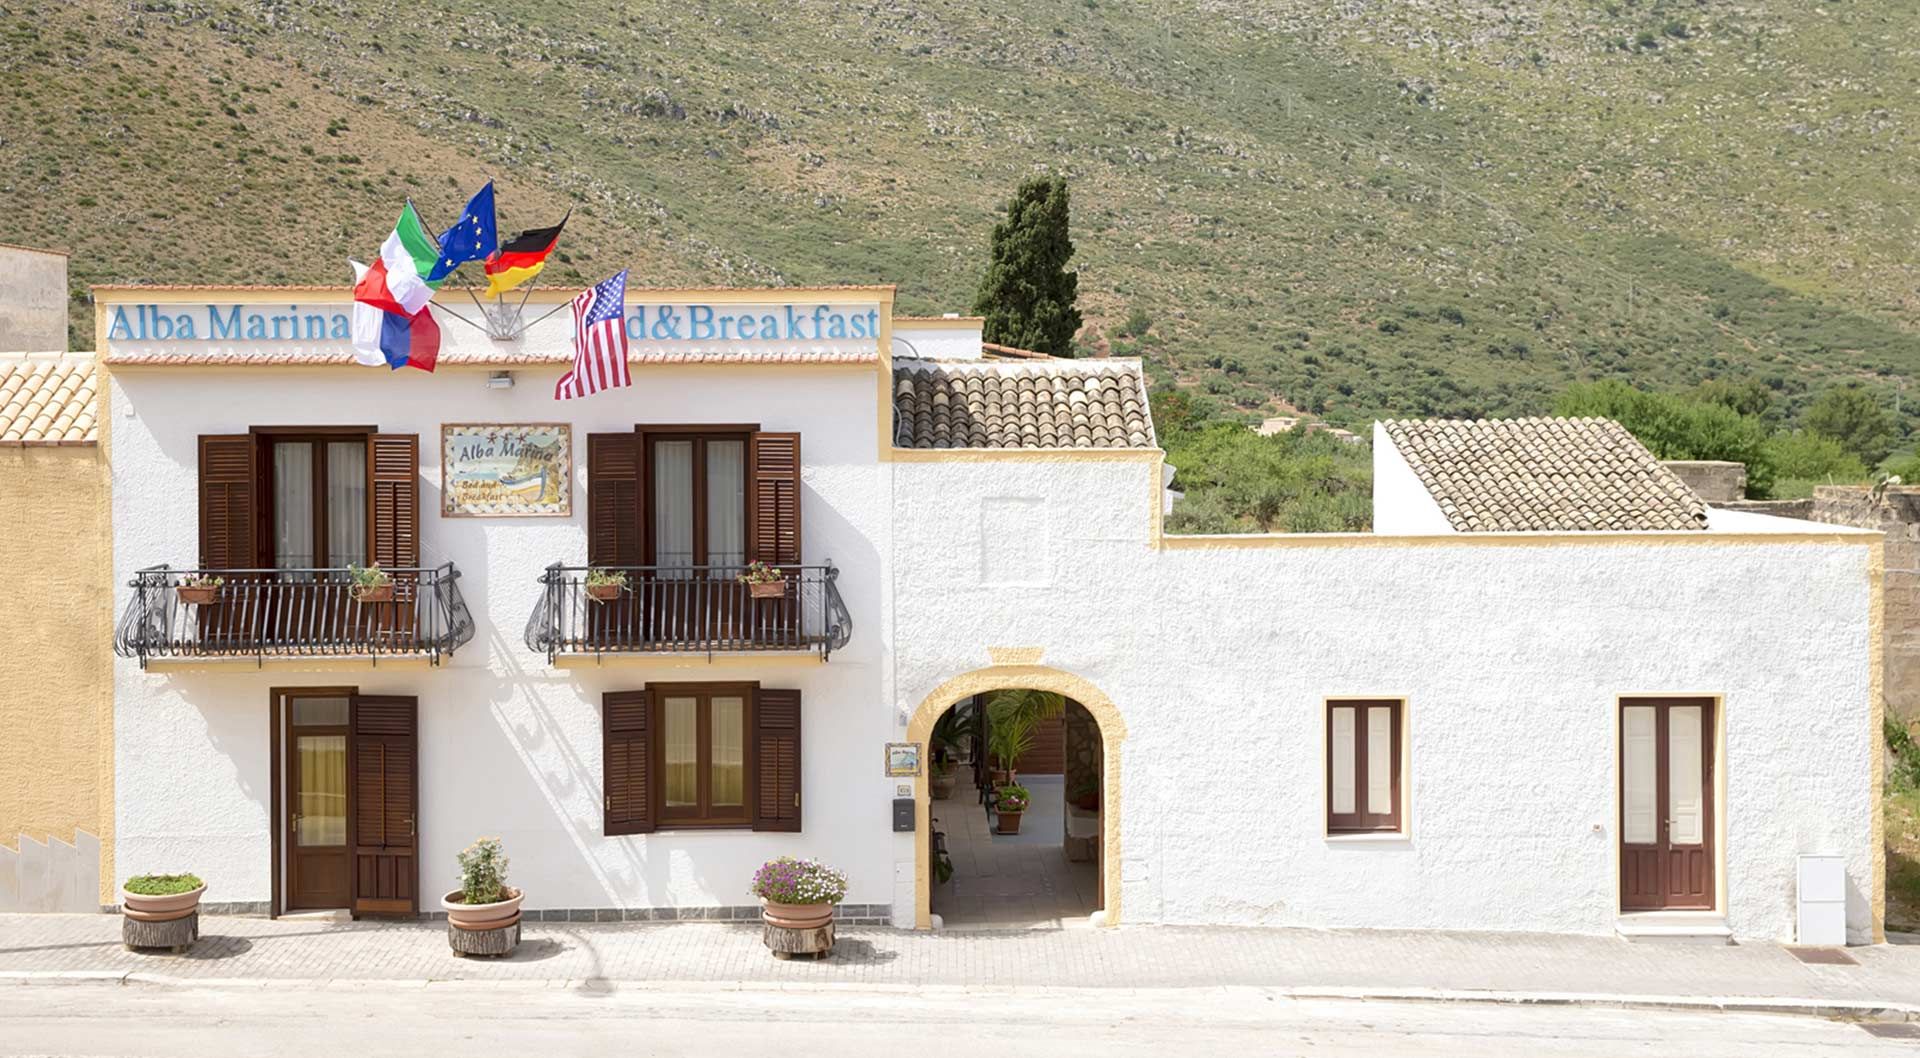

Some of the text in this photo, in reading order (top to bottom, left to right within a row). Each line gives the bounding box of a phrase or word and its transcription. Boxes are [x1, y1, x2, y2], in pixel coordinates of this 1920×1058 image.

[107, 304, 879, 340] Alba Marina d&Breakfast
[460, 443, 554, 462] Alba Marina
